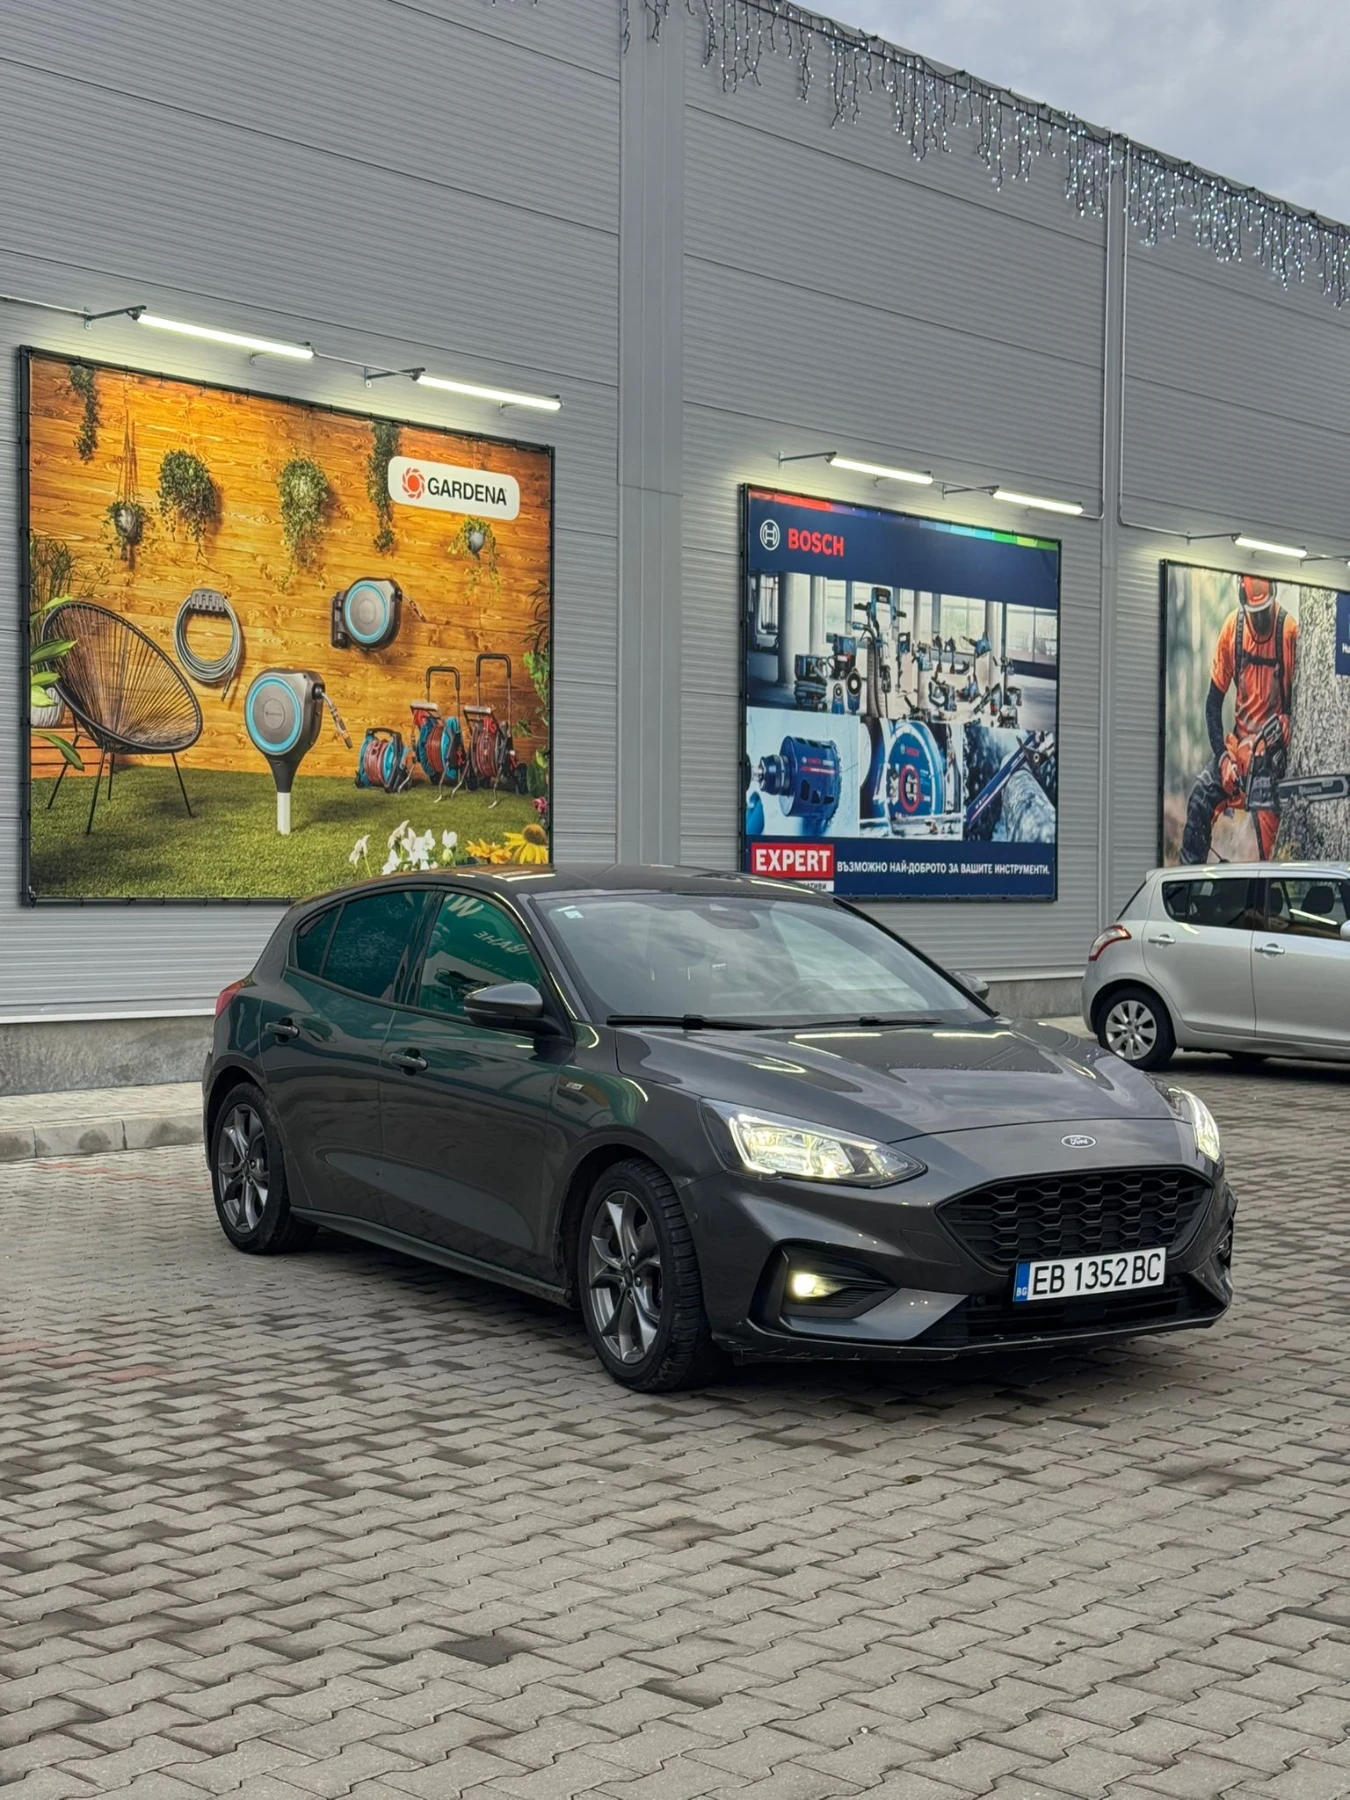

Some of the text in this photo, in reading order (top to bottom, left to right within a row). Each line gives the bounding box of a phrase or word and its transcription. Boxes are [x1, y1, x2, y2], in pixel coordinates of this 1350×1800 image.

[427, 477, 507, 506] GARDENA
[788, 528, 844, 557] BOSCH
[755, 849, 830, 872] EXPERT
[837, 860, 1050, 875] ВЪЗМОЖНО НАЙ-ДОБРОТО ЗА ВАШИТЕ ИНСТРУМЕНТИ.
[1032, 1252, 1161, 1296] EB 1352 BC
[1016, 1286, 1027, 1297] BG
